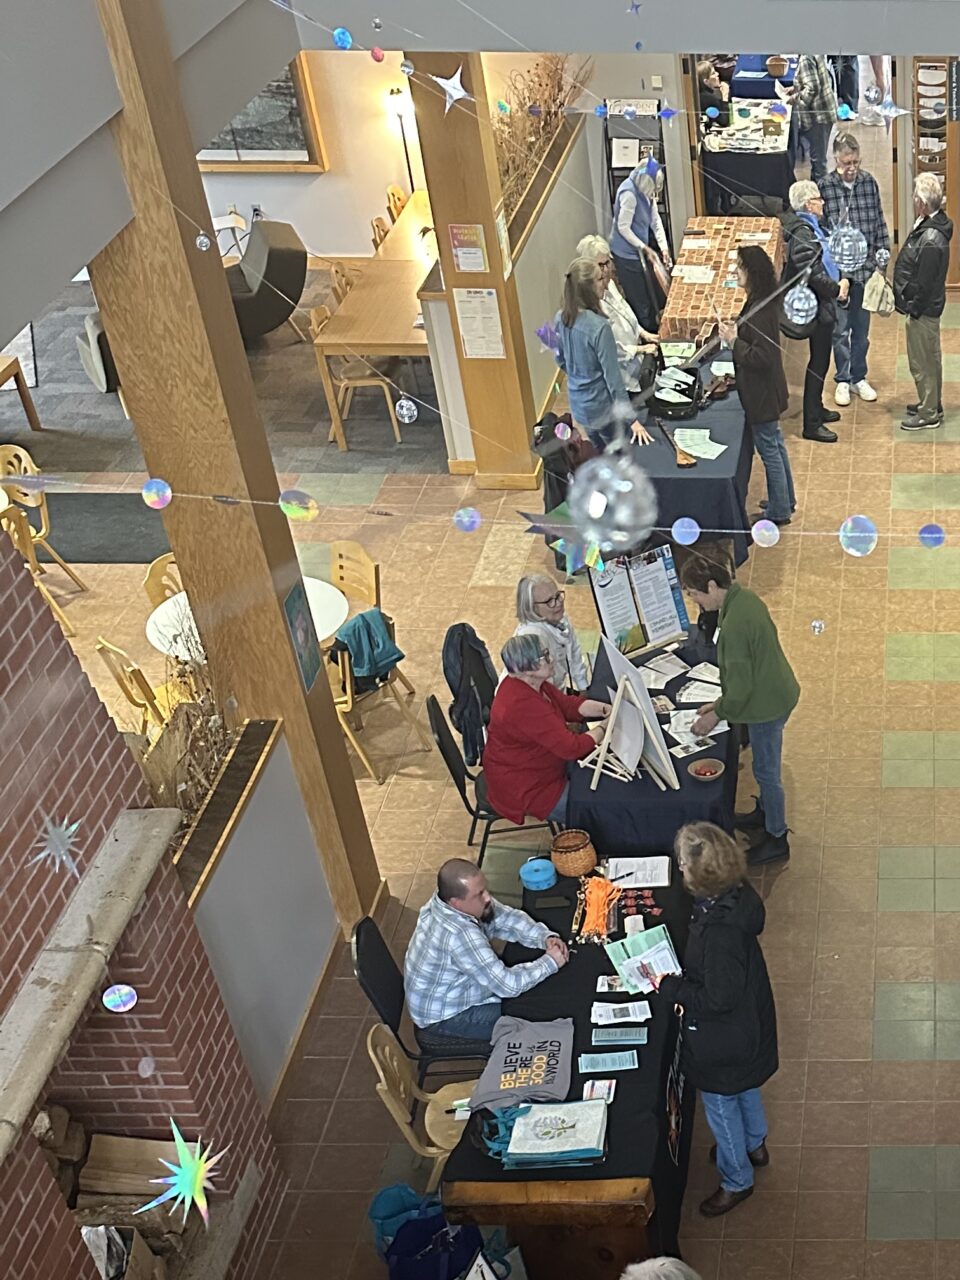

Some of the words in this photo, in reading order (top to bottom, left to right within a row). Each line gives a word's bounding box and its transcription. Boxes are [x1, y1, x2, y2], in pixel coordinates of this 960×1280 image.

[535, 1040, 549, 1052] IN
[545, 1040, 562, 1078] WORLD
[500, 1042, 523, 1090] BELIEVE
[515, 1055, 533, 1089] THERE
[529, 1054, 547, 1086] GOOD
